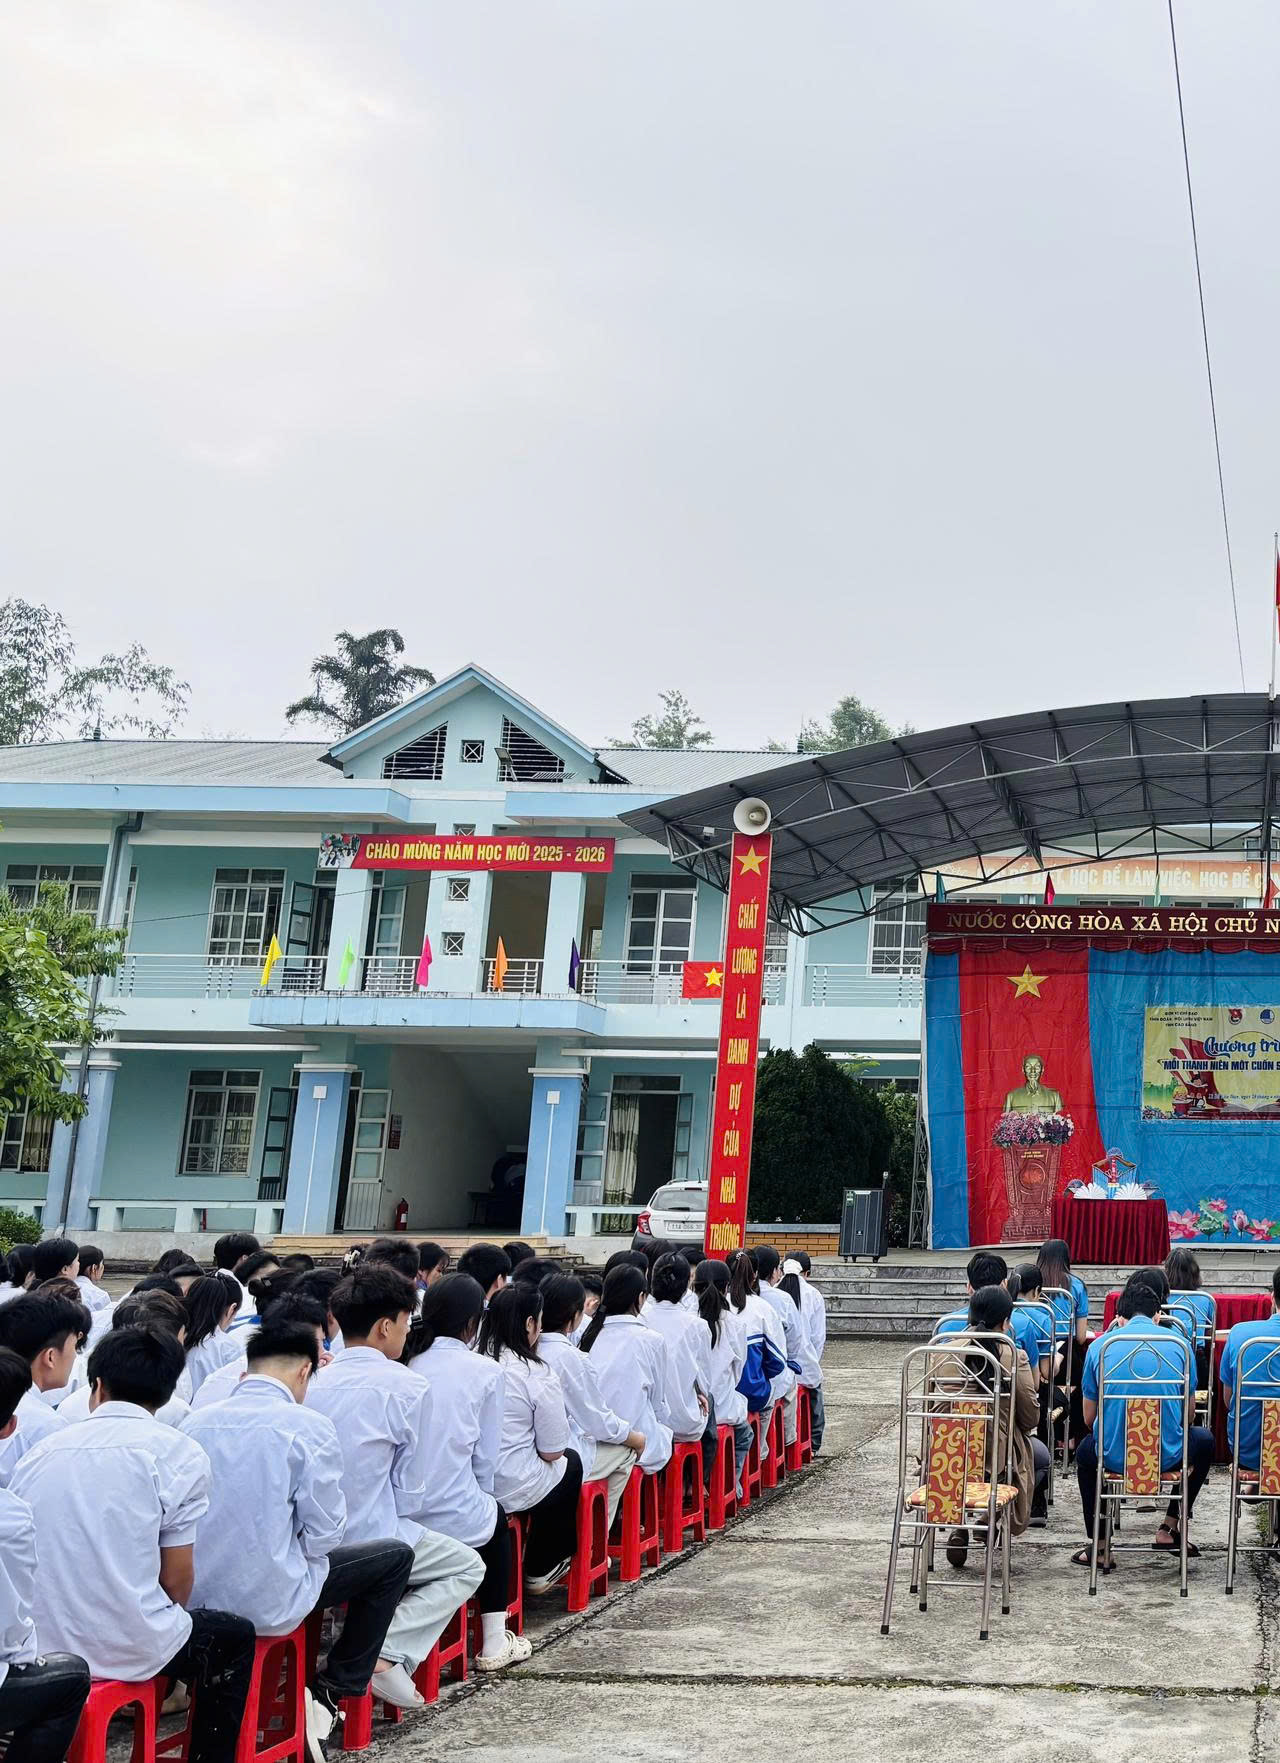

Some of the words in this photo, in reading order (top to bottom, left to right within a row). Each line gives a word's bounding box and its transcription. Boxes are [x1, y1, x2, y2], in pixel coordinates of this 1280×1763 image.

[365, 841, 400, 861] CHÀO
[403, 841, 441, 861] MỪNG
[444, 841, 473, 861] NĂM
[477, 844, 502, 864] HỌC
[505, 841, 530, 862] MỚI
[533, 846, 563, 862] 2025
[575, 846, 606, 862] 2026
[1071, 869, 1098, 890] HỌC
[1104, 863, 1122, 887] ĐỂ
[1200, 871, 1228, 891] HỌC
[1232, 866, 1251, 889] ĐỂ
[738, 896, 760, 929] CHẤT
[948, 907, 1007, 928] NƯỚC
[1011, 910, 1072, 933] CỘNG
[1078, 911, 1125, 931] HÒA
[1131, 912, 1163, 932] XÃ
[1168, 911, 1209, 935] HỘI
[1214, 912, 1257, 932] CHỦ
[731, 946, 757, 979] LƯỢNG
[735, 988, 747, 1019] LÀ
[727, 1038, 750, 1065] DANH
[1204, 1036, 1255, 1058] Chương
[1182, 1060, 1209, 1070] THANH
[1210, 1058, 1229, 1070] NIÊN
[1231, 1059, 1249, 1072] MỘT
[1252, 1058, 1274, 1070] CUỐN
[728, 1081, 743, 1116] DỰ
[723, 1120, 740, 1157] CỦA
[719, 1171, 737, 1204] NHÀ
[709, 1217, 741, 1251] TRƯỜNG
